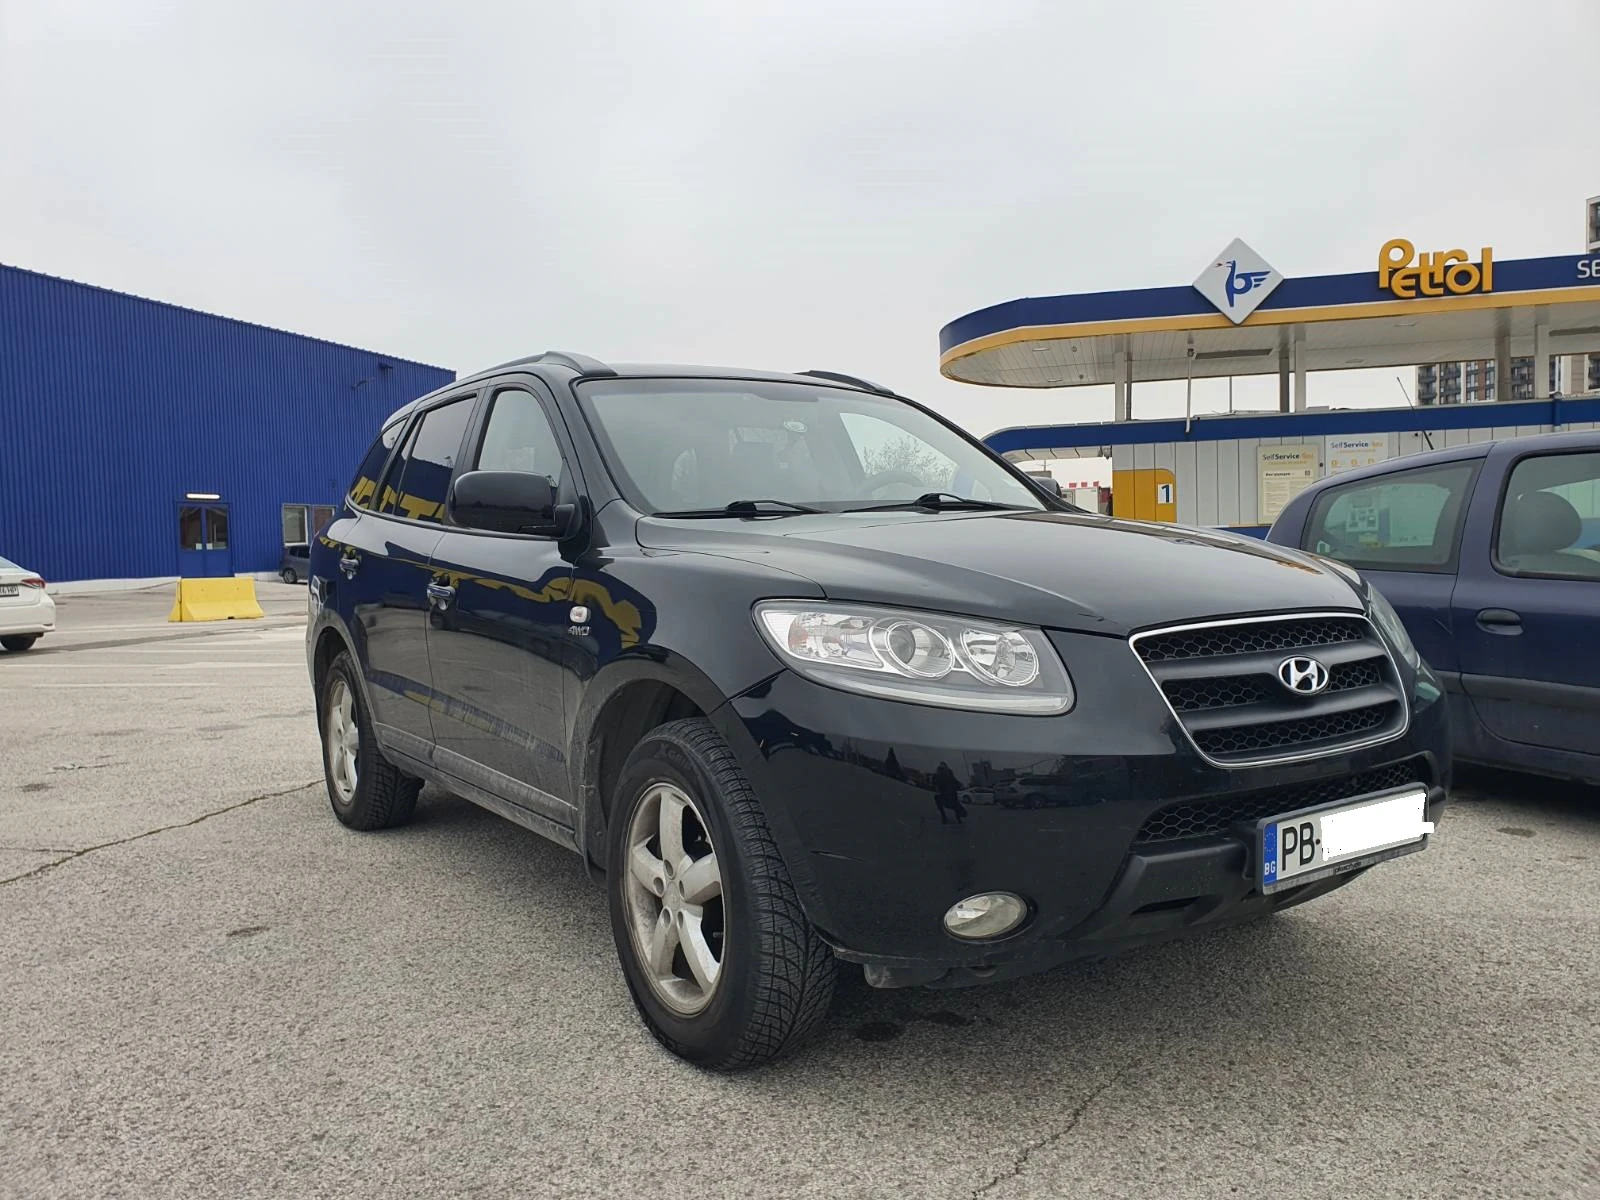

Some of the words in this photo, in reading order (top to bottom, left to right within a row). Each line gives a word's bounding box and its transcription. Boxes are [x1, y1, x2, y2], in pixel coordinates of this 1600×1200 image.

[1379, 238, 1493, 298] Petrol
[1161, 484, 1170, 503] 1
[1264, 861, 1276, 876] BG
